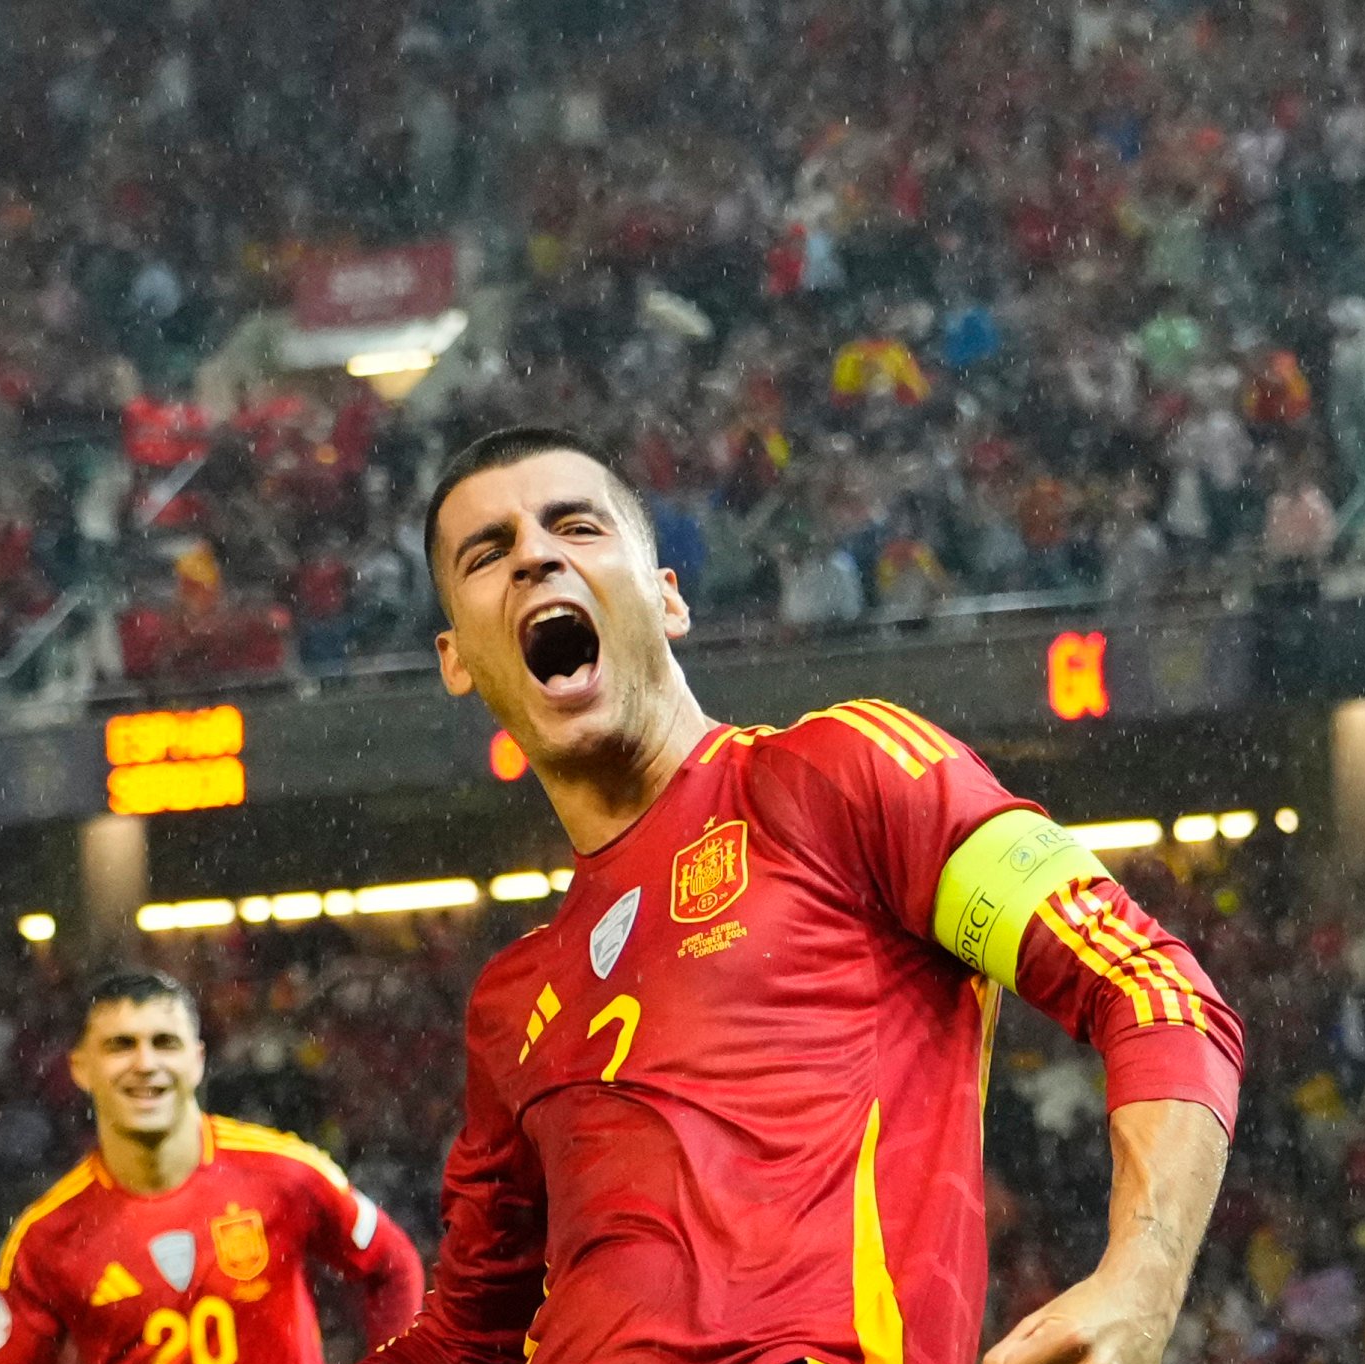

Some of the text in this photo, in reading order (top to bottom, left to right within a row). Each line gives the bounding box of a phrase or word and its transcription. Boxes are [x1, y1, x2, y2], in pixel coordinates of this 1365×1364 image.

[682, 932, 704, 948] SPAIN
[711, 920, 740, 936] SERBIA
[688, 933, 723, 952] OCTOBER
[725, 926, 748, 940] 2024
[587, 994, 641, 1081] 7
